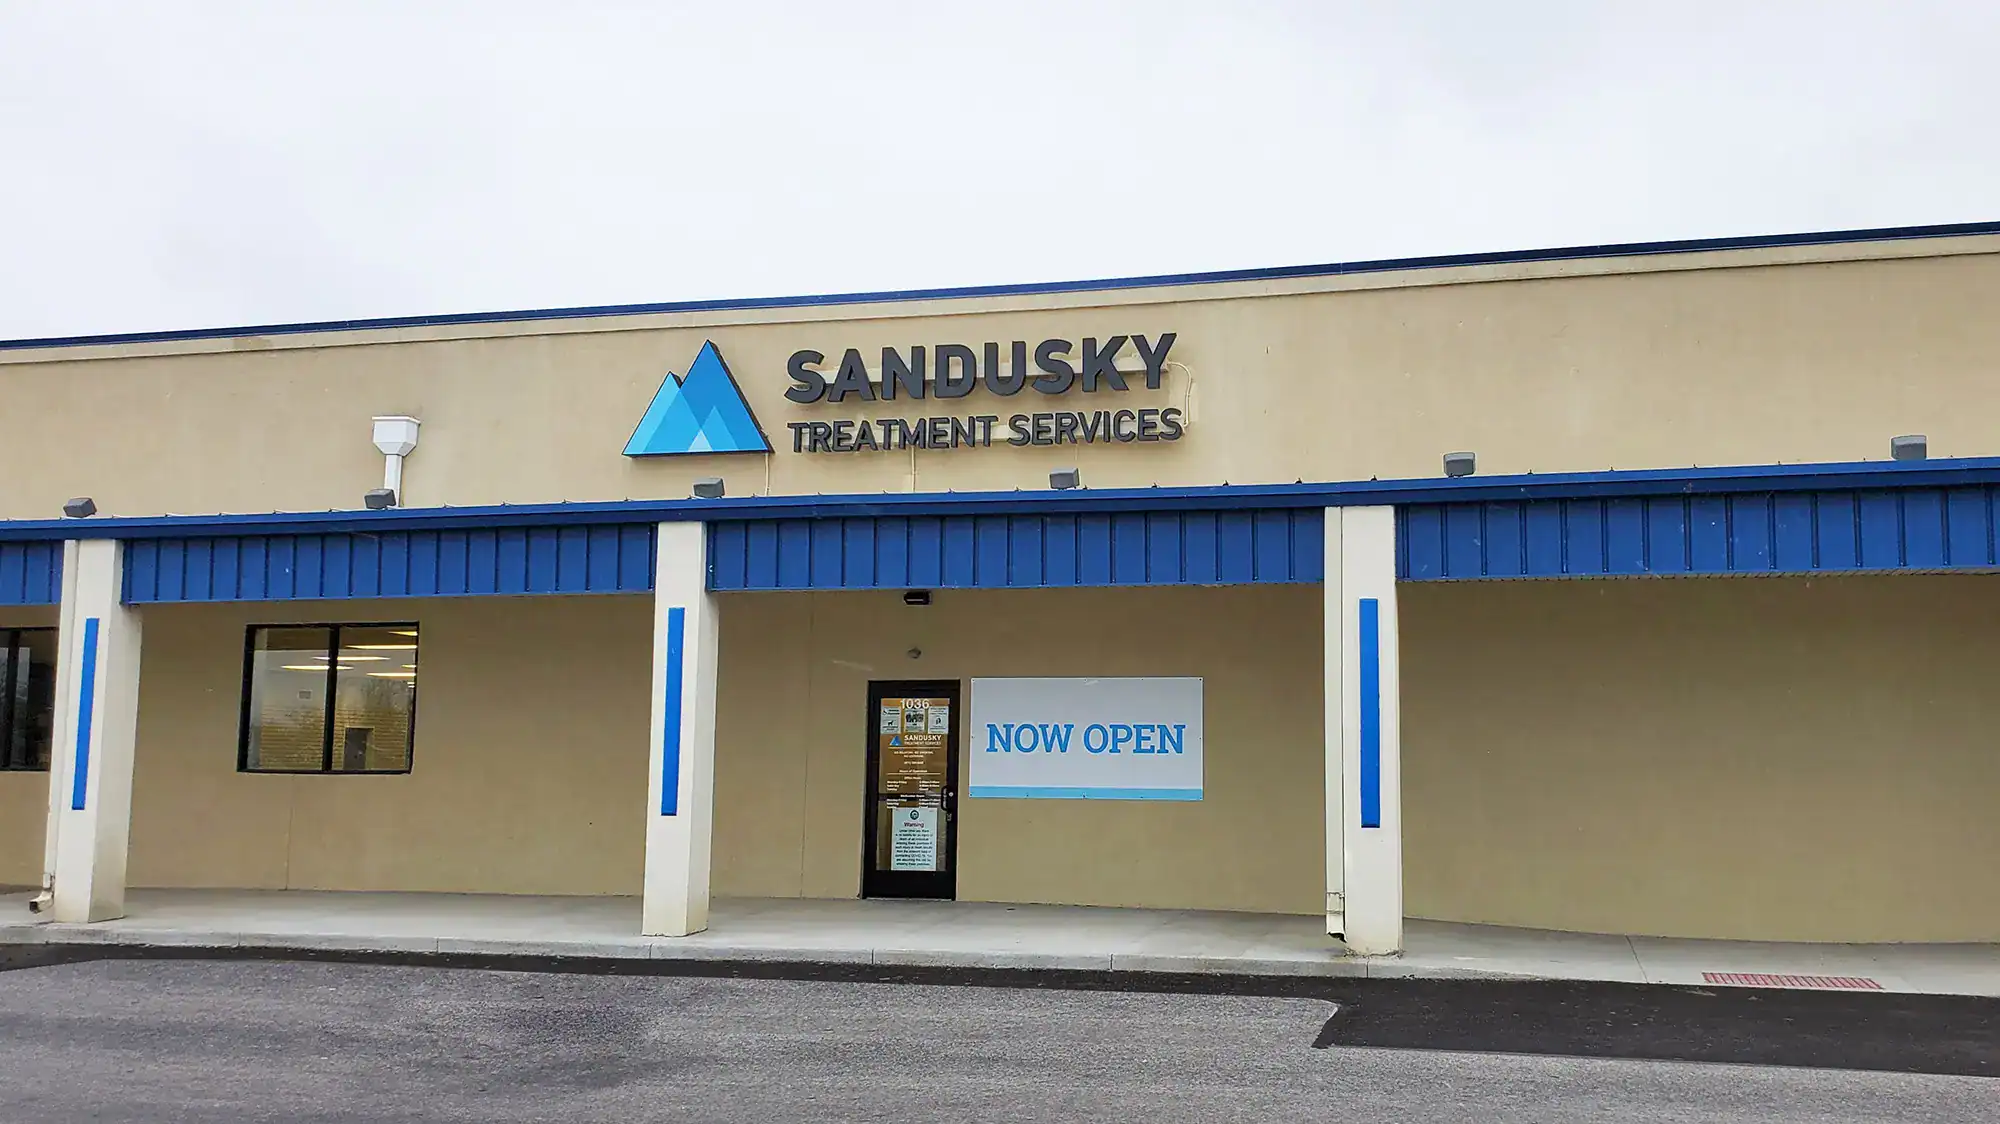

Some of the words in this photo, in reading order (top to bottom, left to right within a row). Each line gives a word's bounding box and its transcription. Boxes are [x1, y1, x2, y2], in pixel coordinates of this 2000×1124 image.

[784, 332, 1177, 404] SANDUSKY
[787, 415, 999, 452] TREATMENT
[1006, 407, 1183, 447] SERVICES
[901, 698, 930, 709] 1036
[985, 723, 1074, 753] NOW
[1083, 723, 1186, 754] OPEN
